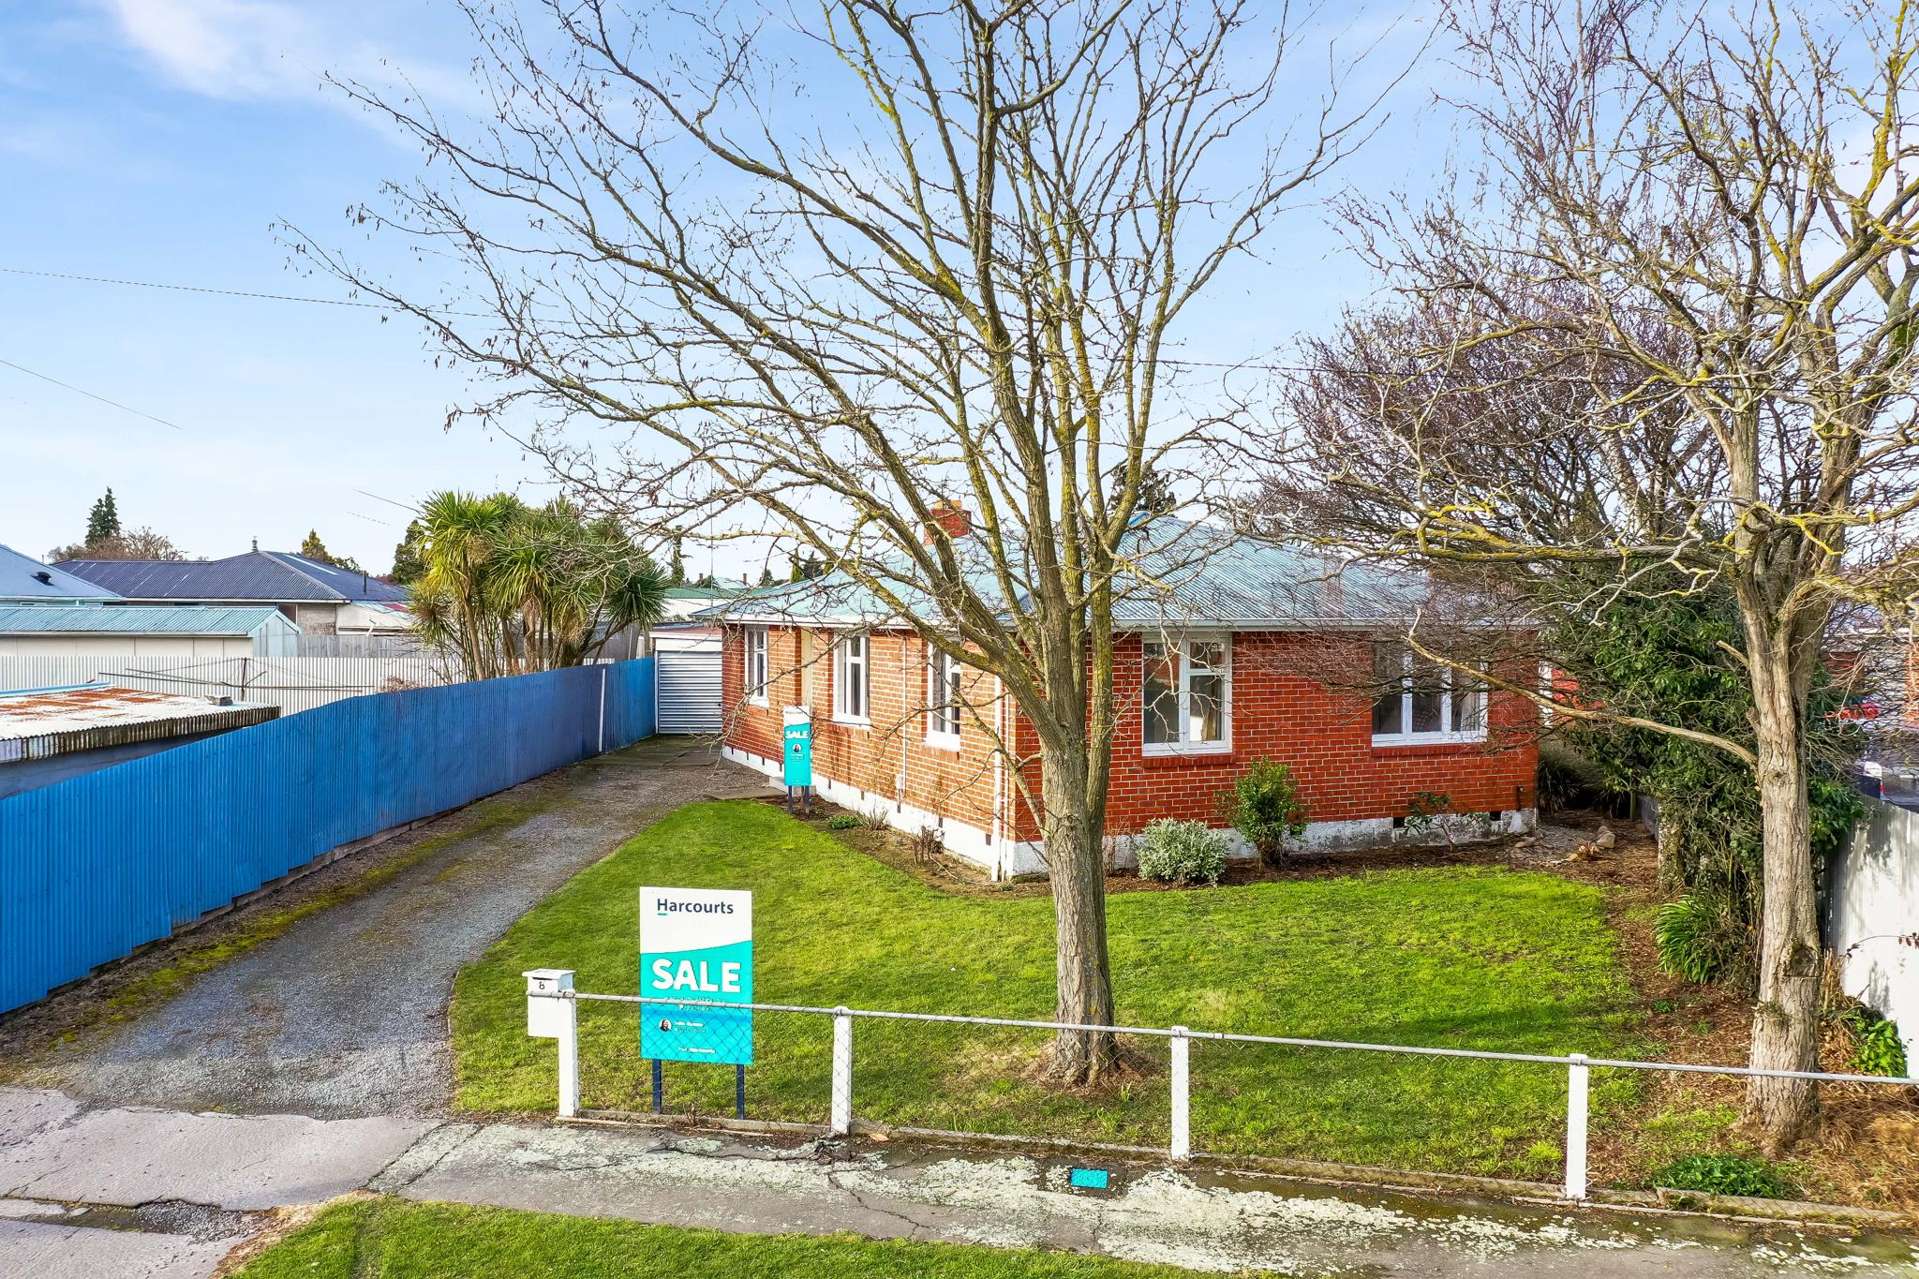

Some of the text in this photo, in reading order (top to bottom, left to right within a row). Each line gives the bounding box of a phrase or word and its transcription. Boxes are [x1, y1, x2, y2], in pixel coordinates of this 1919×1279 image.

[785, 730, 809, 739] SALE
[657, 898, 734, 914] Harcourts
[652, 958, 741, 992] SALE
